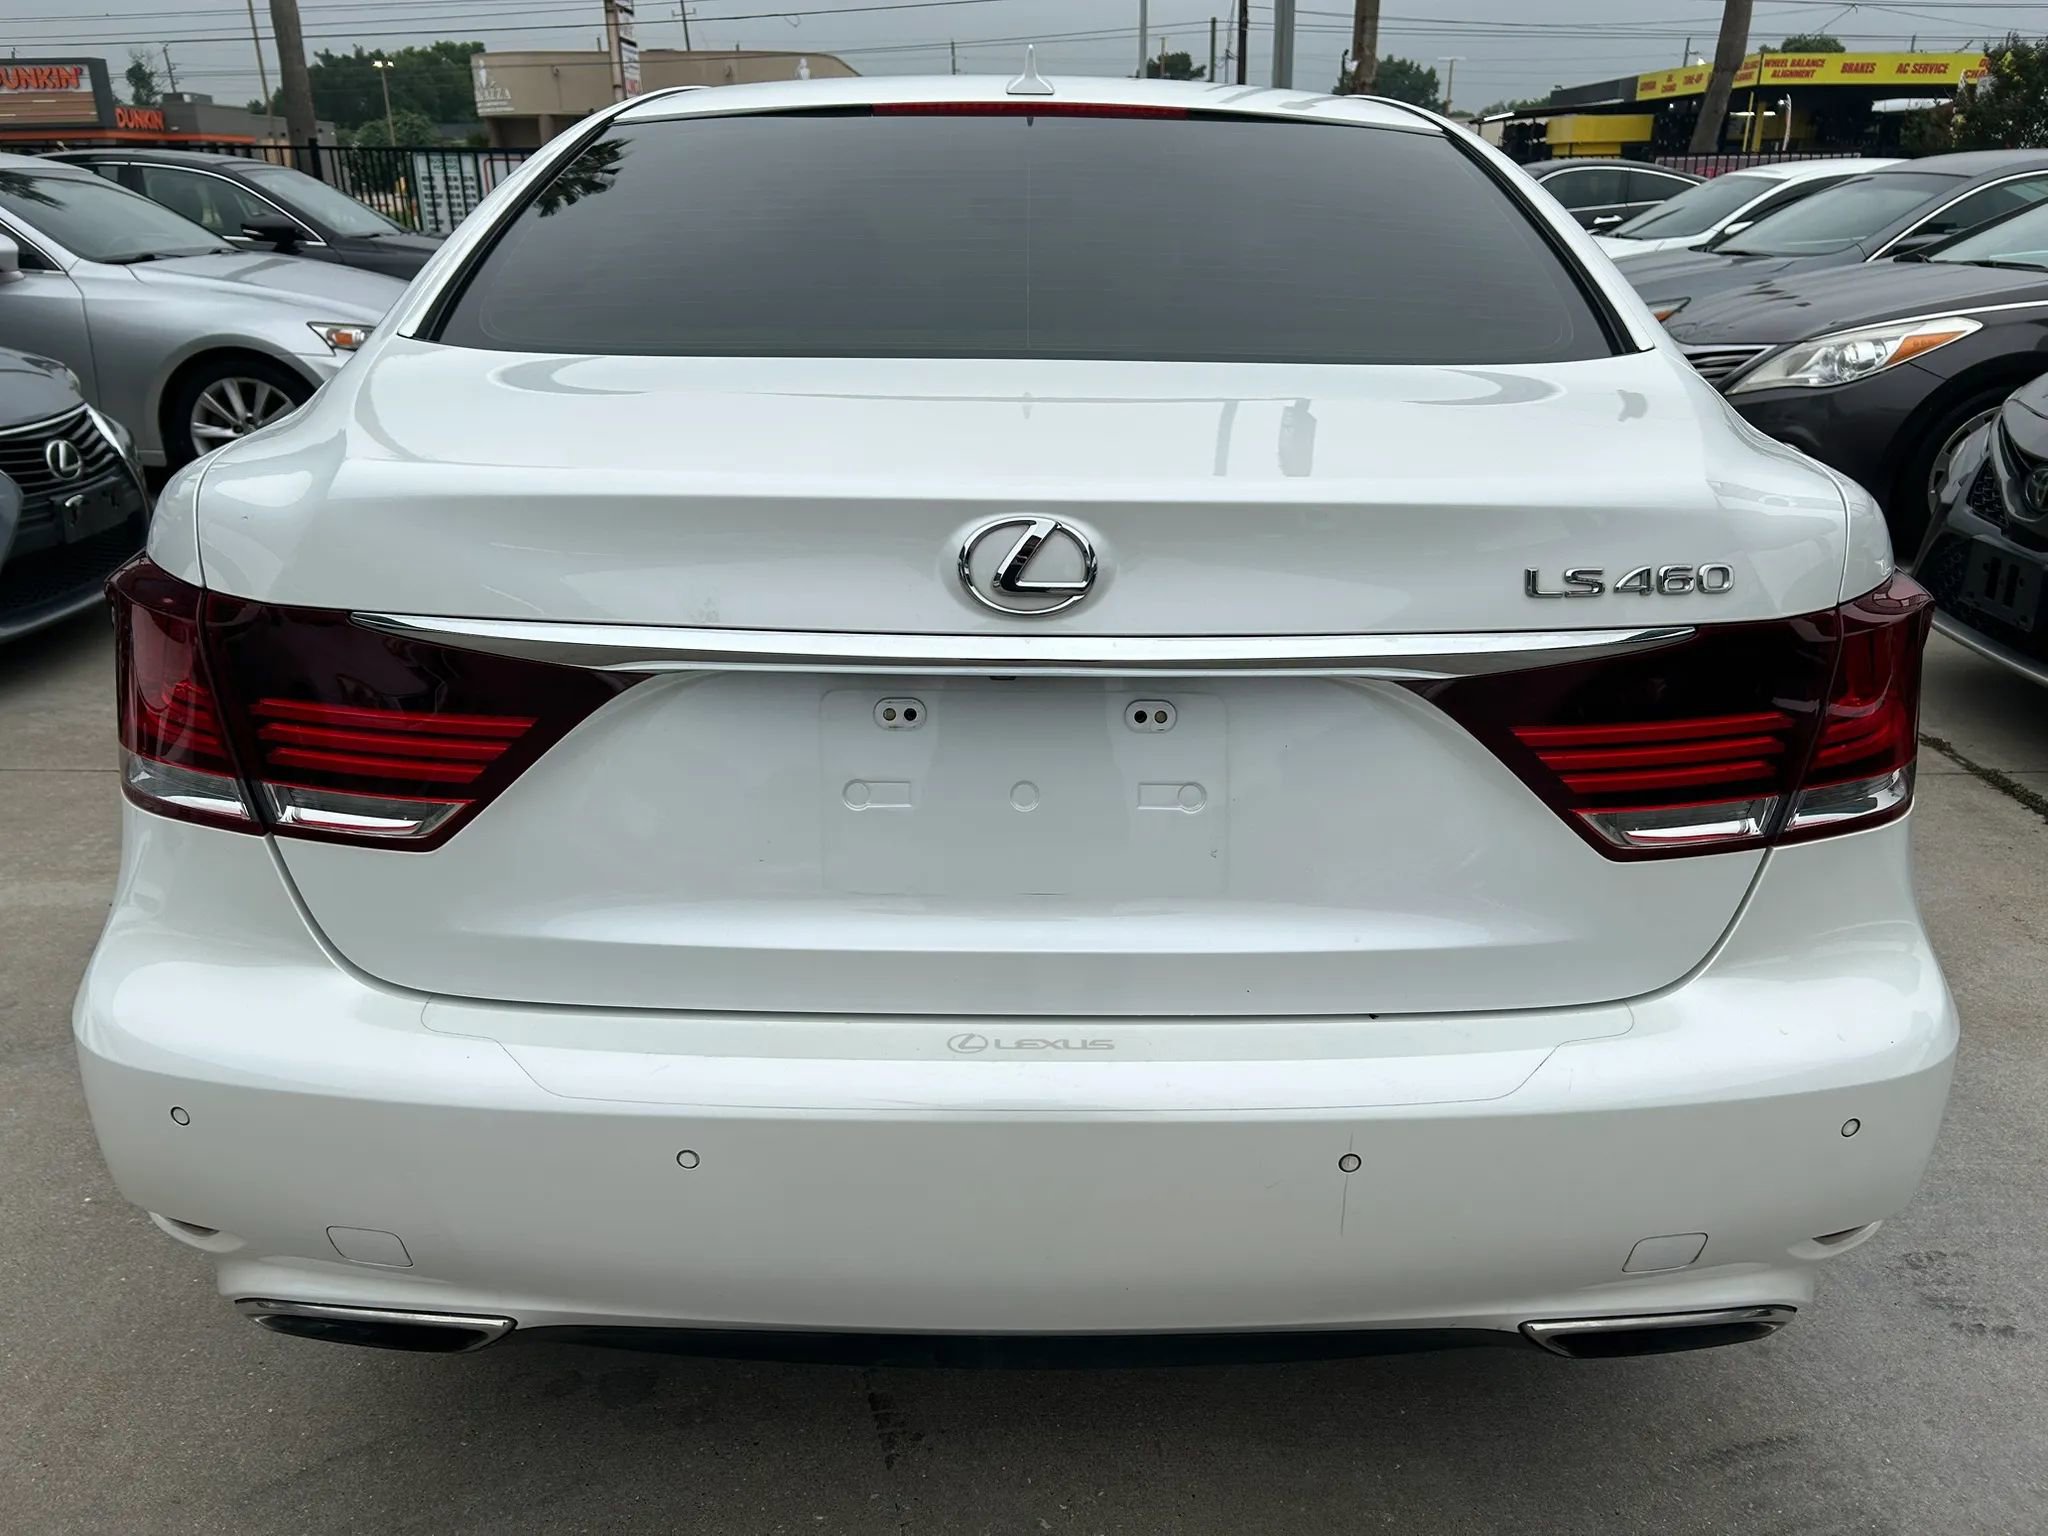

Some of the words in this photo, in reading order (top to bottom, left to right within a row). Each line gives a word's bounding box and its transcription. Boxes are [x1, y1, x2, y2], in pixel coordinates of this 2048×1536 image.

[1764, 59, 1788, 68] WHEEL
[1790, 59, 1825, 68] BALANCE
[1841, 63, 1876, 74] BRAKES
[1896, 63, 1911, 74] AC
[1911, 63, 1950, 74] SERVICE
[1770, 69, 1817, 78] ALIGNMENT
[1524, 565, 1606, 599] LS
[1613, 562, 1735, 597] 460
[994, 1038, 1115, 1050] LEXUS
